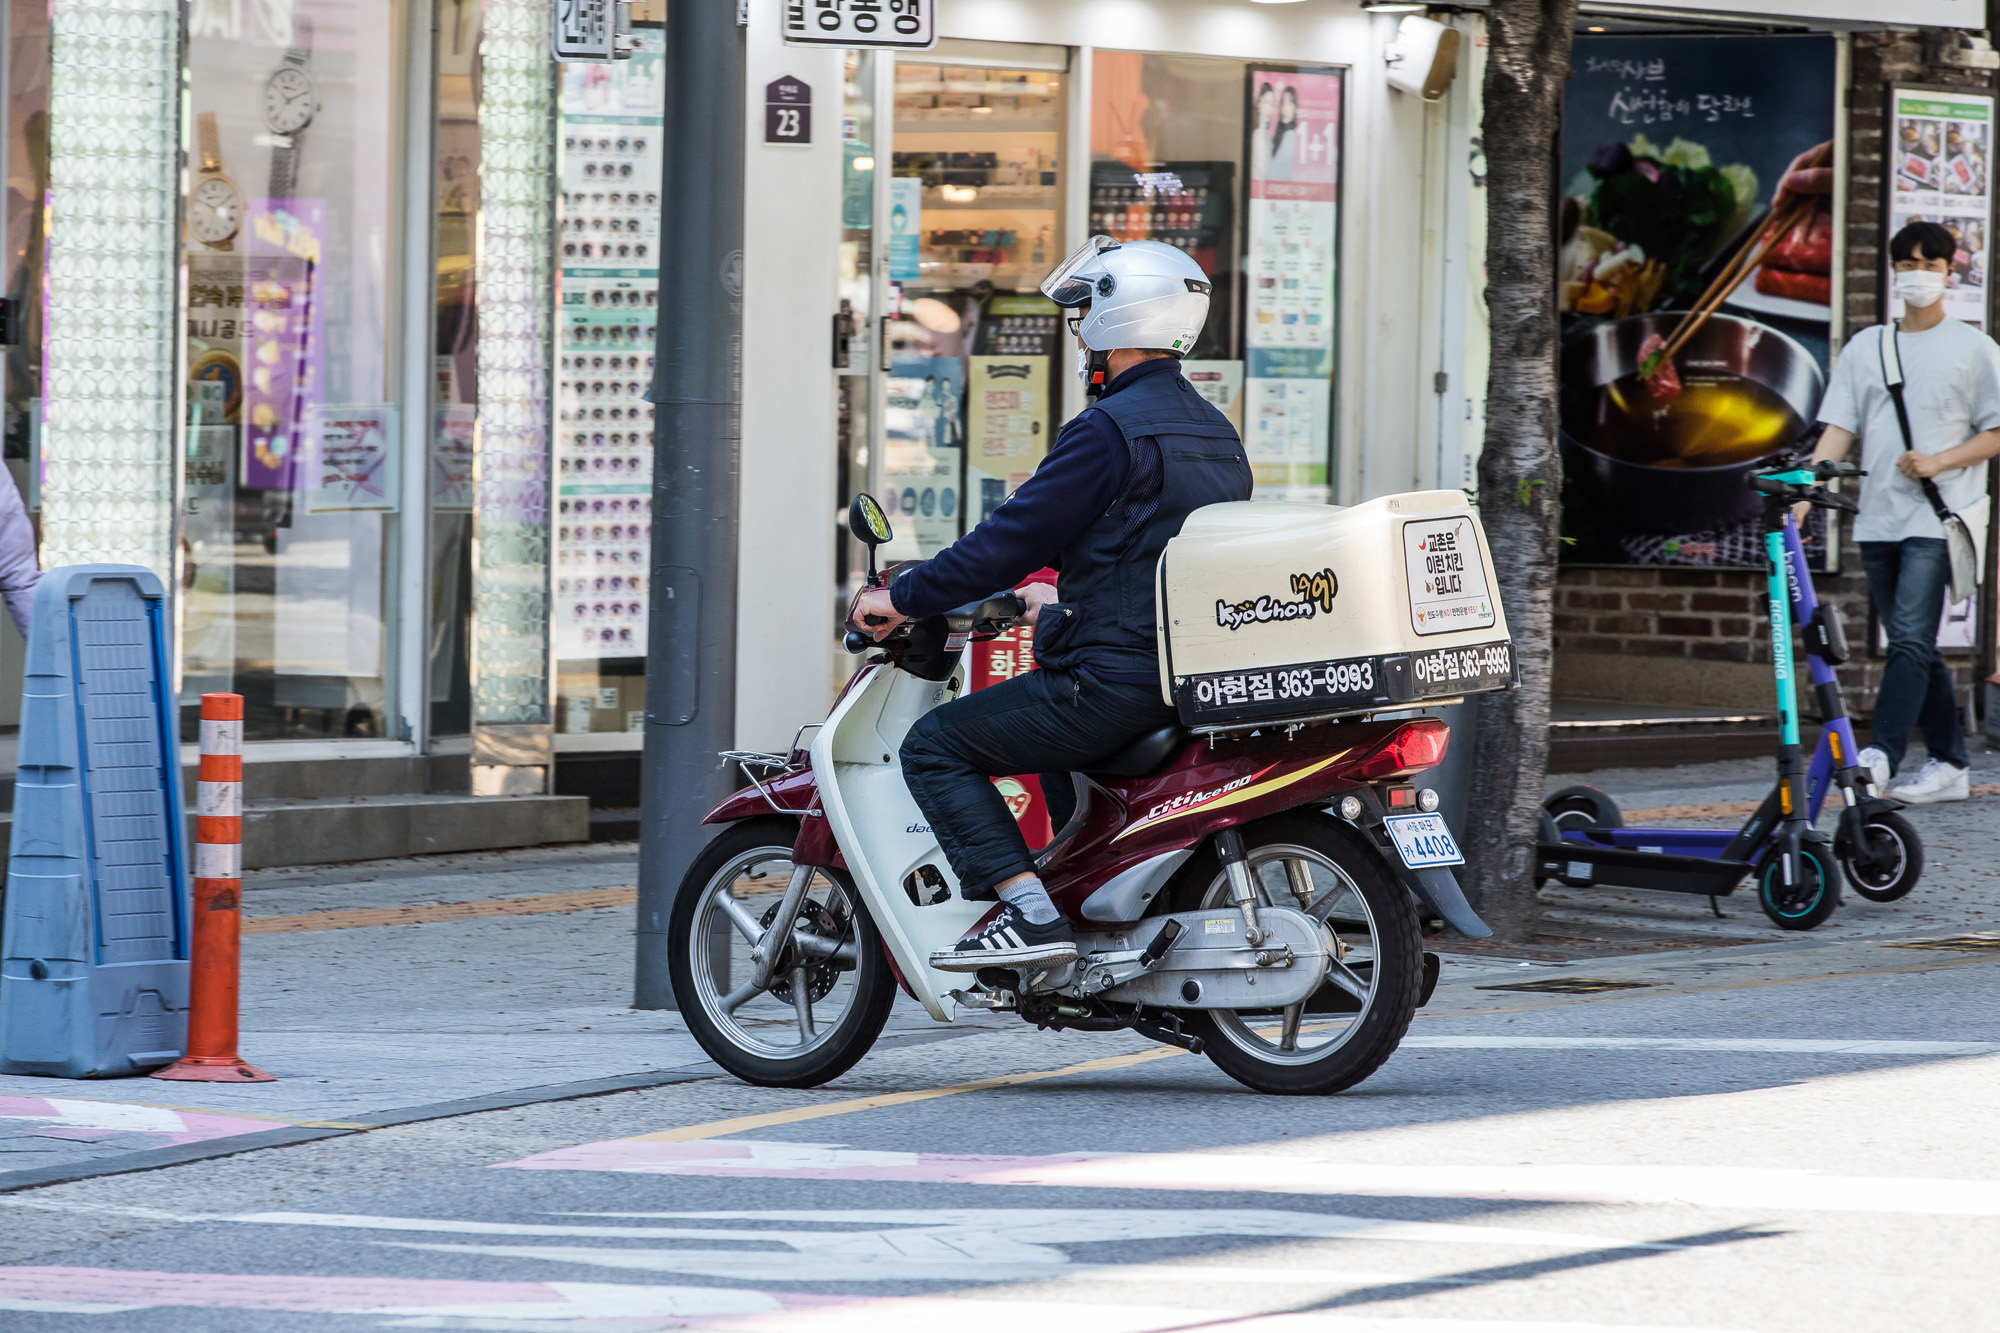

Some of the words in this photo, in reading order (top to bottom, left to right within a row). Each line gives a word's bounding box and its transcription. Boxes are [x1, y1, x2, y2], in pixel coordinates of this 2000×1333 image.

[776, 109, 800, 136] 23
[1297, 121, 1335, 166] 1+1
[1427, 532, 1456, 552] 교촌은
[1426, 554, 1445, 574] 이런
[1445, 553, 1464, 572] 치킨
[1290, 568, 1339, 613] 1991
[1435, 574, 1462, 595] 입니다
[1217, 596, 1314, 630] KyoChon
[1415, 650, 1459, 684] 아현점
[1460, 645, 1511, 679] 363-9993
[1197, 672, 1274, 706] 아현점
[1278, 662, 1374, 698] 363-9993
[1414, 834, 1456, 859] 4408
